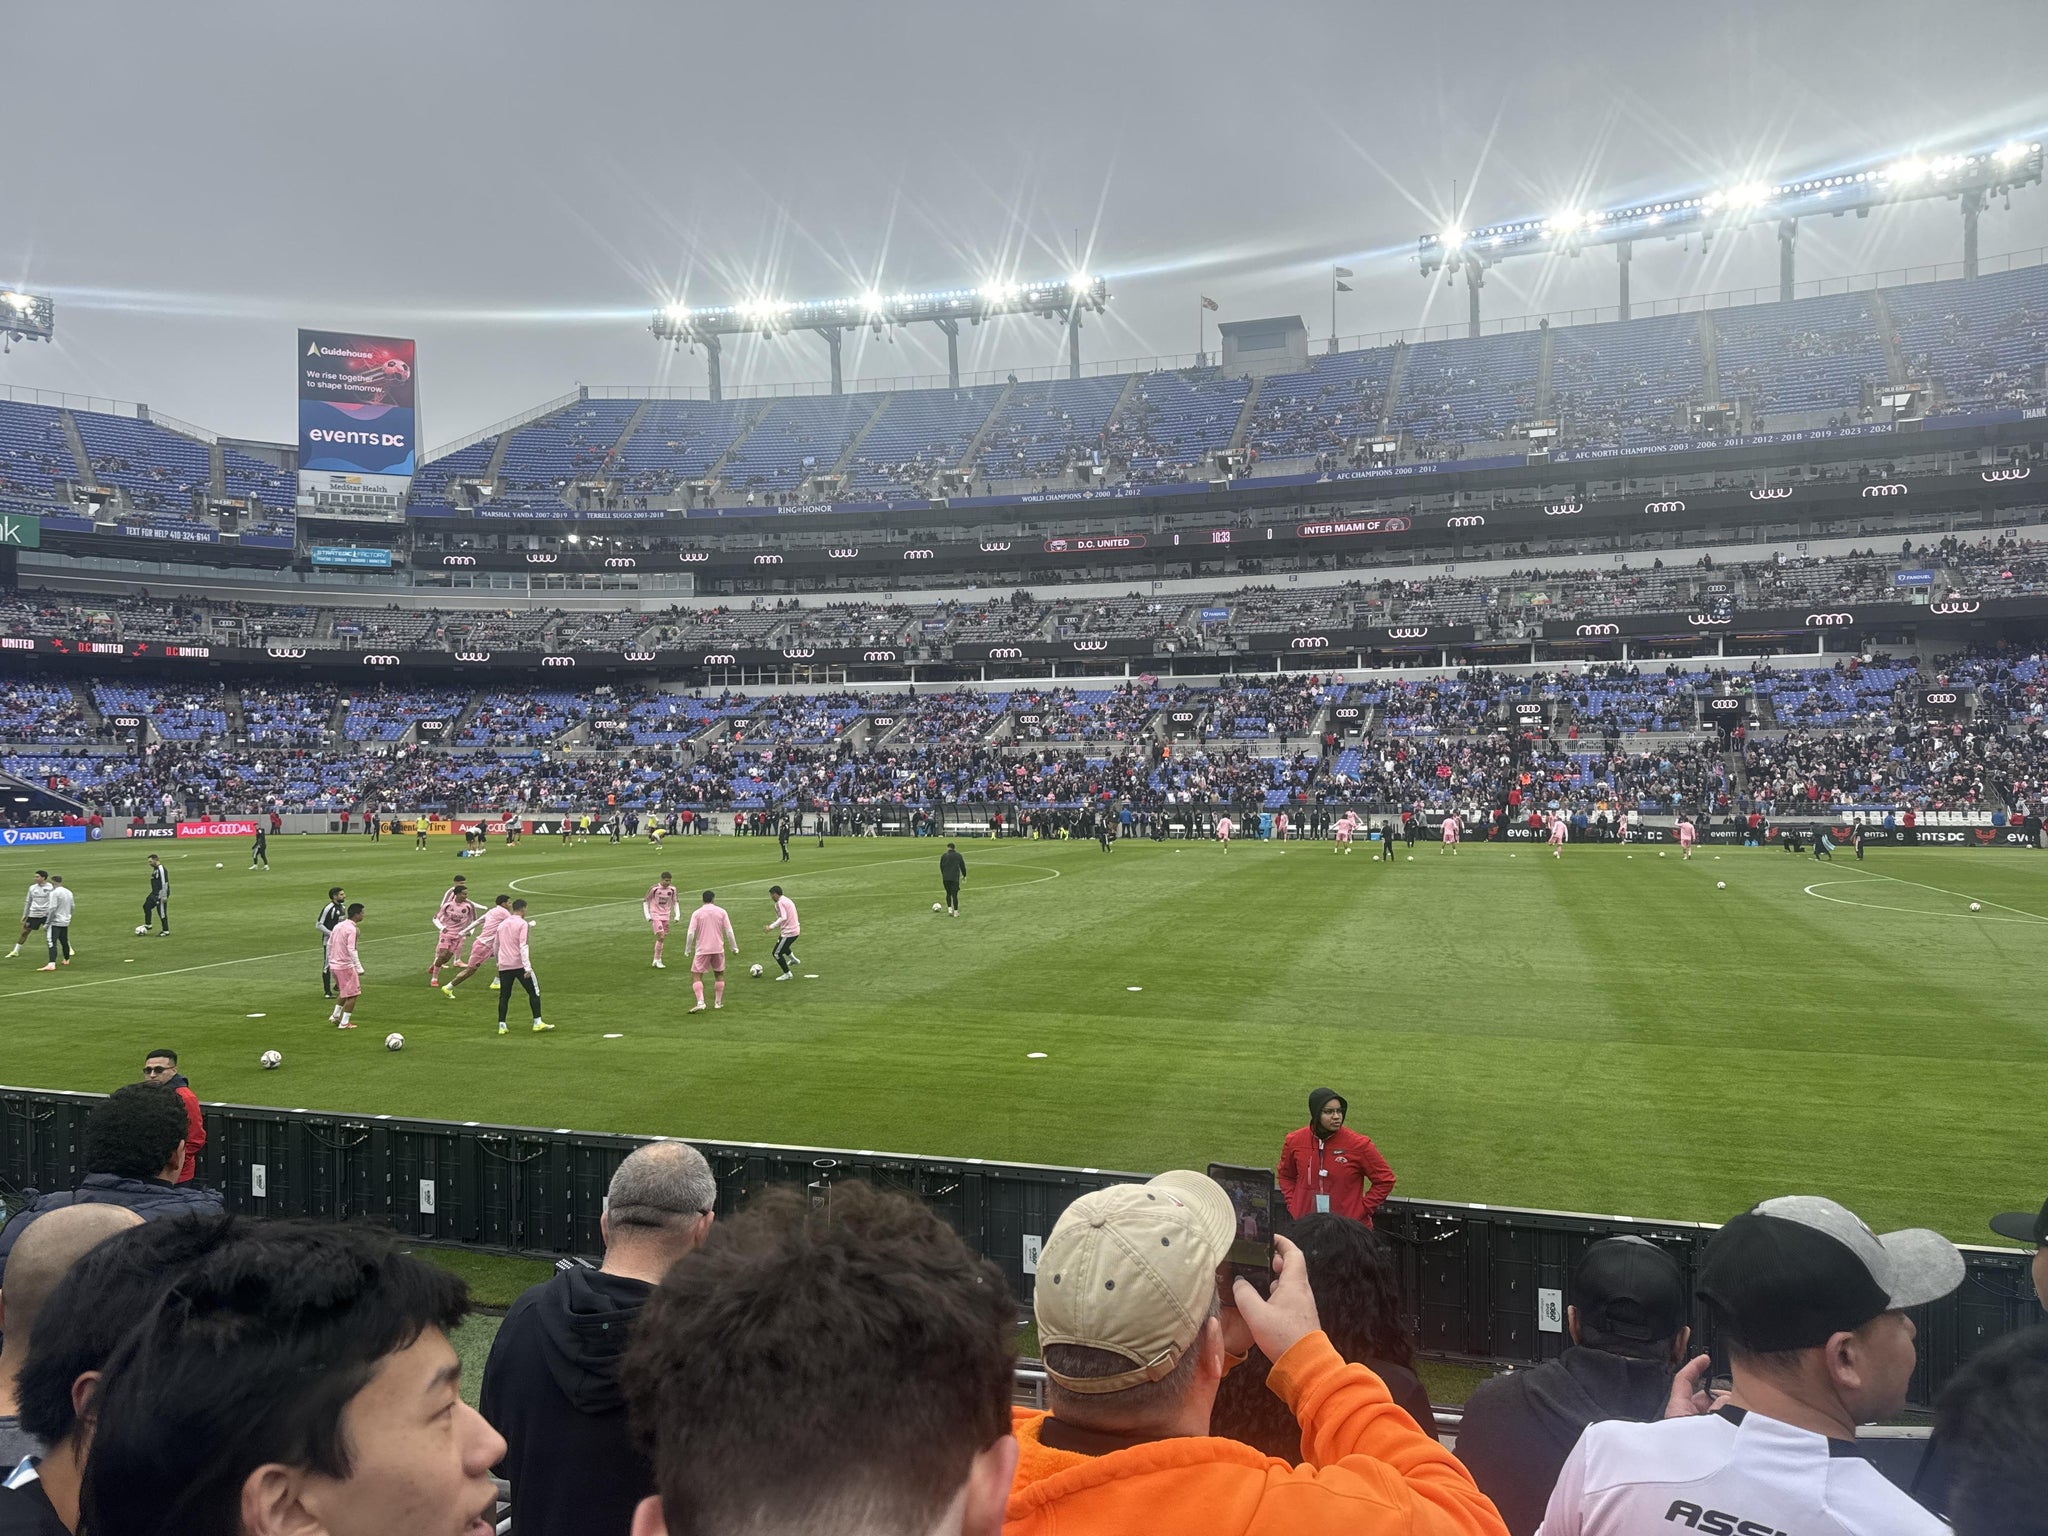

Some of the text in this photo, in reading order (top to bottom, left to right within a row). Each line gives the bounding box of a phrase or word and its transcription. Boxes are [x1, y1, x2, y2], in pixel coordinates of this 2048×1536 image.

[321, 346, 373, 359] Guidehouse
[306, 370, 373, 383] We rise together
[317, 381, 342, 391] shape
[344, 384, 385, 393] tomorrow.
[2022, 407, 2048, 419] THANK
[382, 434, 405, 447] DC
[1575, 424, 1892, 459] AFC NORTH CHAMPIONS 2003 2006 2011 2012 2018 2019 2023 2024
[1351, 469, 1393, 478] CHAMPIONS
[1395, 467, 1413, 475] 2000
[1419, 465, 1437, 473] 2012
[331, 483, 388, 493] MedStar Health
[1045, 493, 1082, 502] CHAMPIONS
[535, 511, 568, 519] 2007-2019
[633, 511, 664, 519] 2003-2018
[778, 506, 797, 514] RING
[802, 505, 832, 513] HONOR
[1304, 521, 1380, 535] INTER MIAMI CF
[125, 526, 211, 542] TEXT FOR HELP 410-324-6141
[1174, 534, 1179, 545] 0
[1212, 531, 1230, 543] 10:33
[1267, 528, 1272, 540] 0
[1078, 538, 1130, 548] D.C. UNITED
[1, 638, 34, 650] UNITED
[92, 643, 124, 654] UNITED
[179, 647, 209, 658] UNITED
[20, 830, 65, 841] FANDUEL
[181, 825, 206, 835] Audi
[1947, 832, 1965, 842] DC
